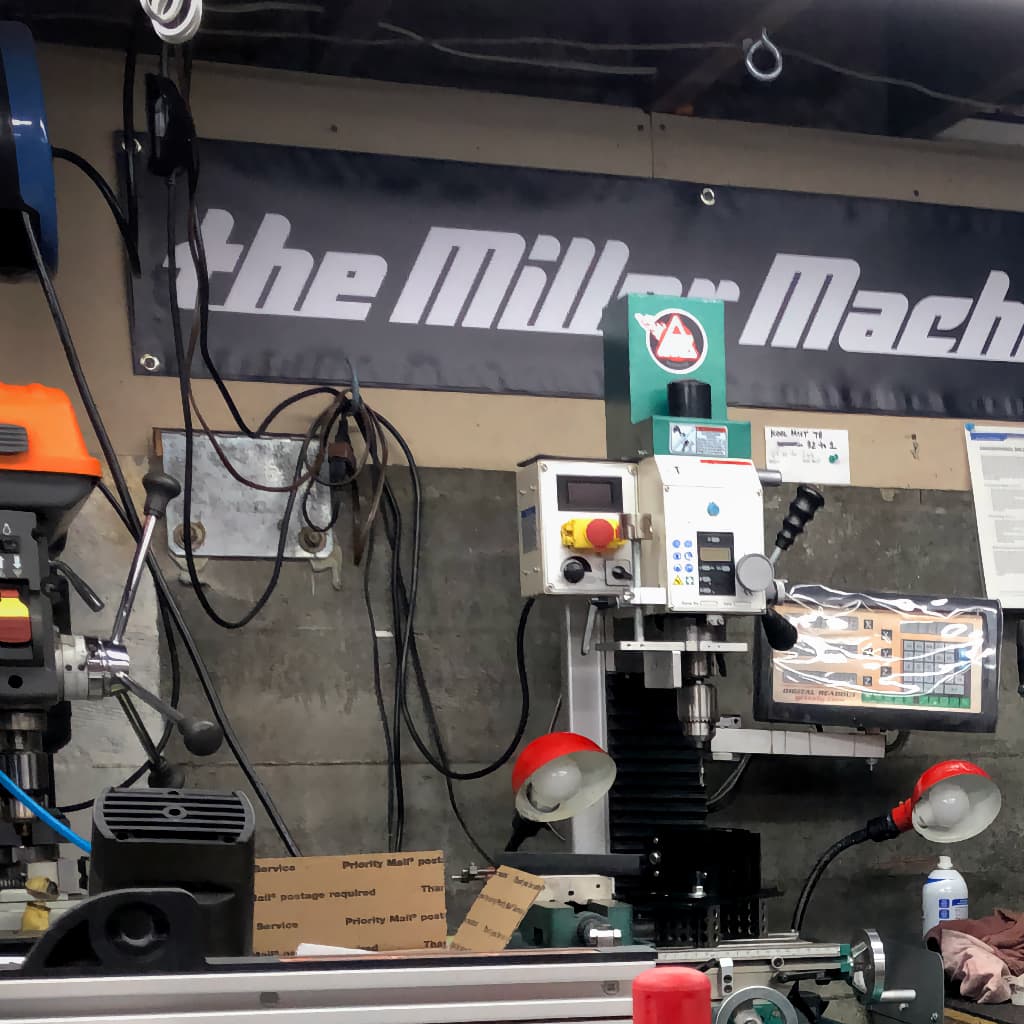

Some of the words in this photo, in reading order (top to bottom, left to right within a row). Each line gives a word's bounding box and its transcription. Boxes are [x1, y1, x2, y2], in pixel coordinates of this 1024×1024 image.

[162, 209, 388, 321] the
[342, 860, 383, 869] Priority
[280, 892, 325, 903] postage
[329, 889, 376, 899] required
[256, 921, 299, 931] Service
[345, 916, 386, 926] Priority
